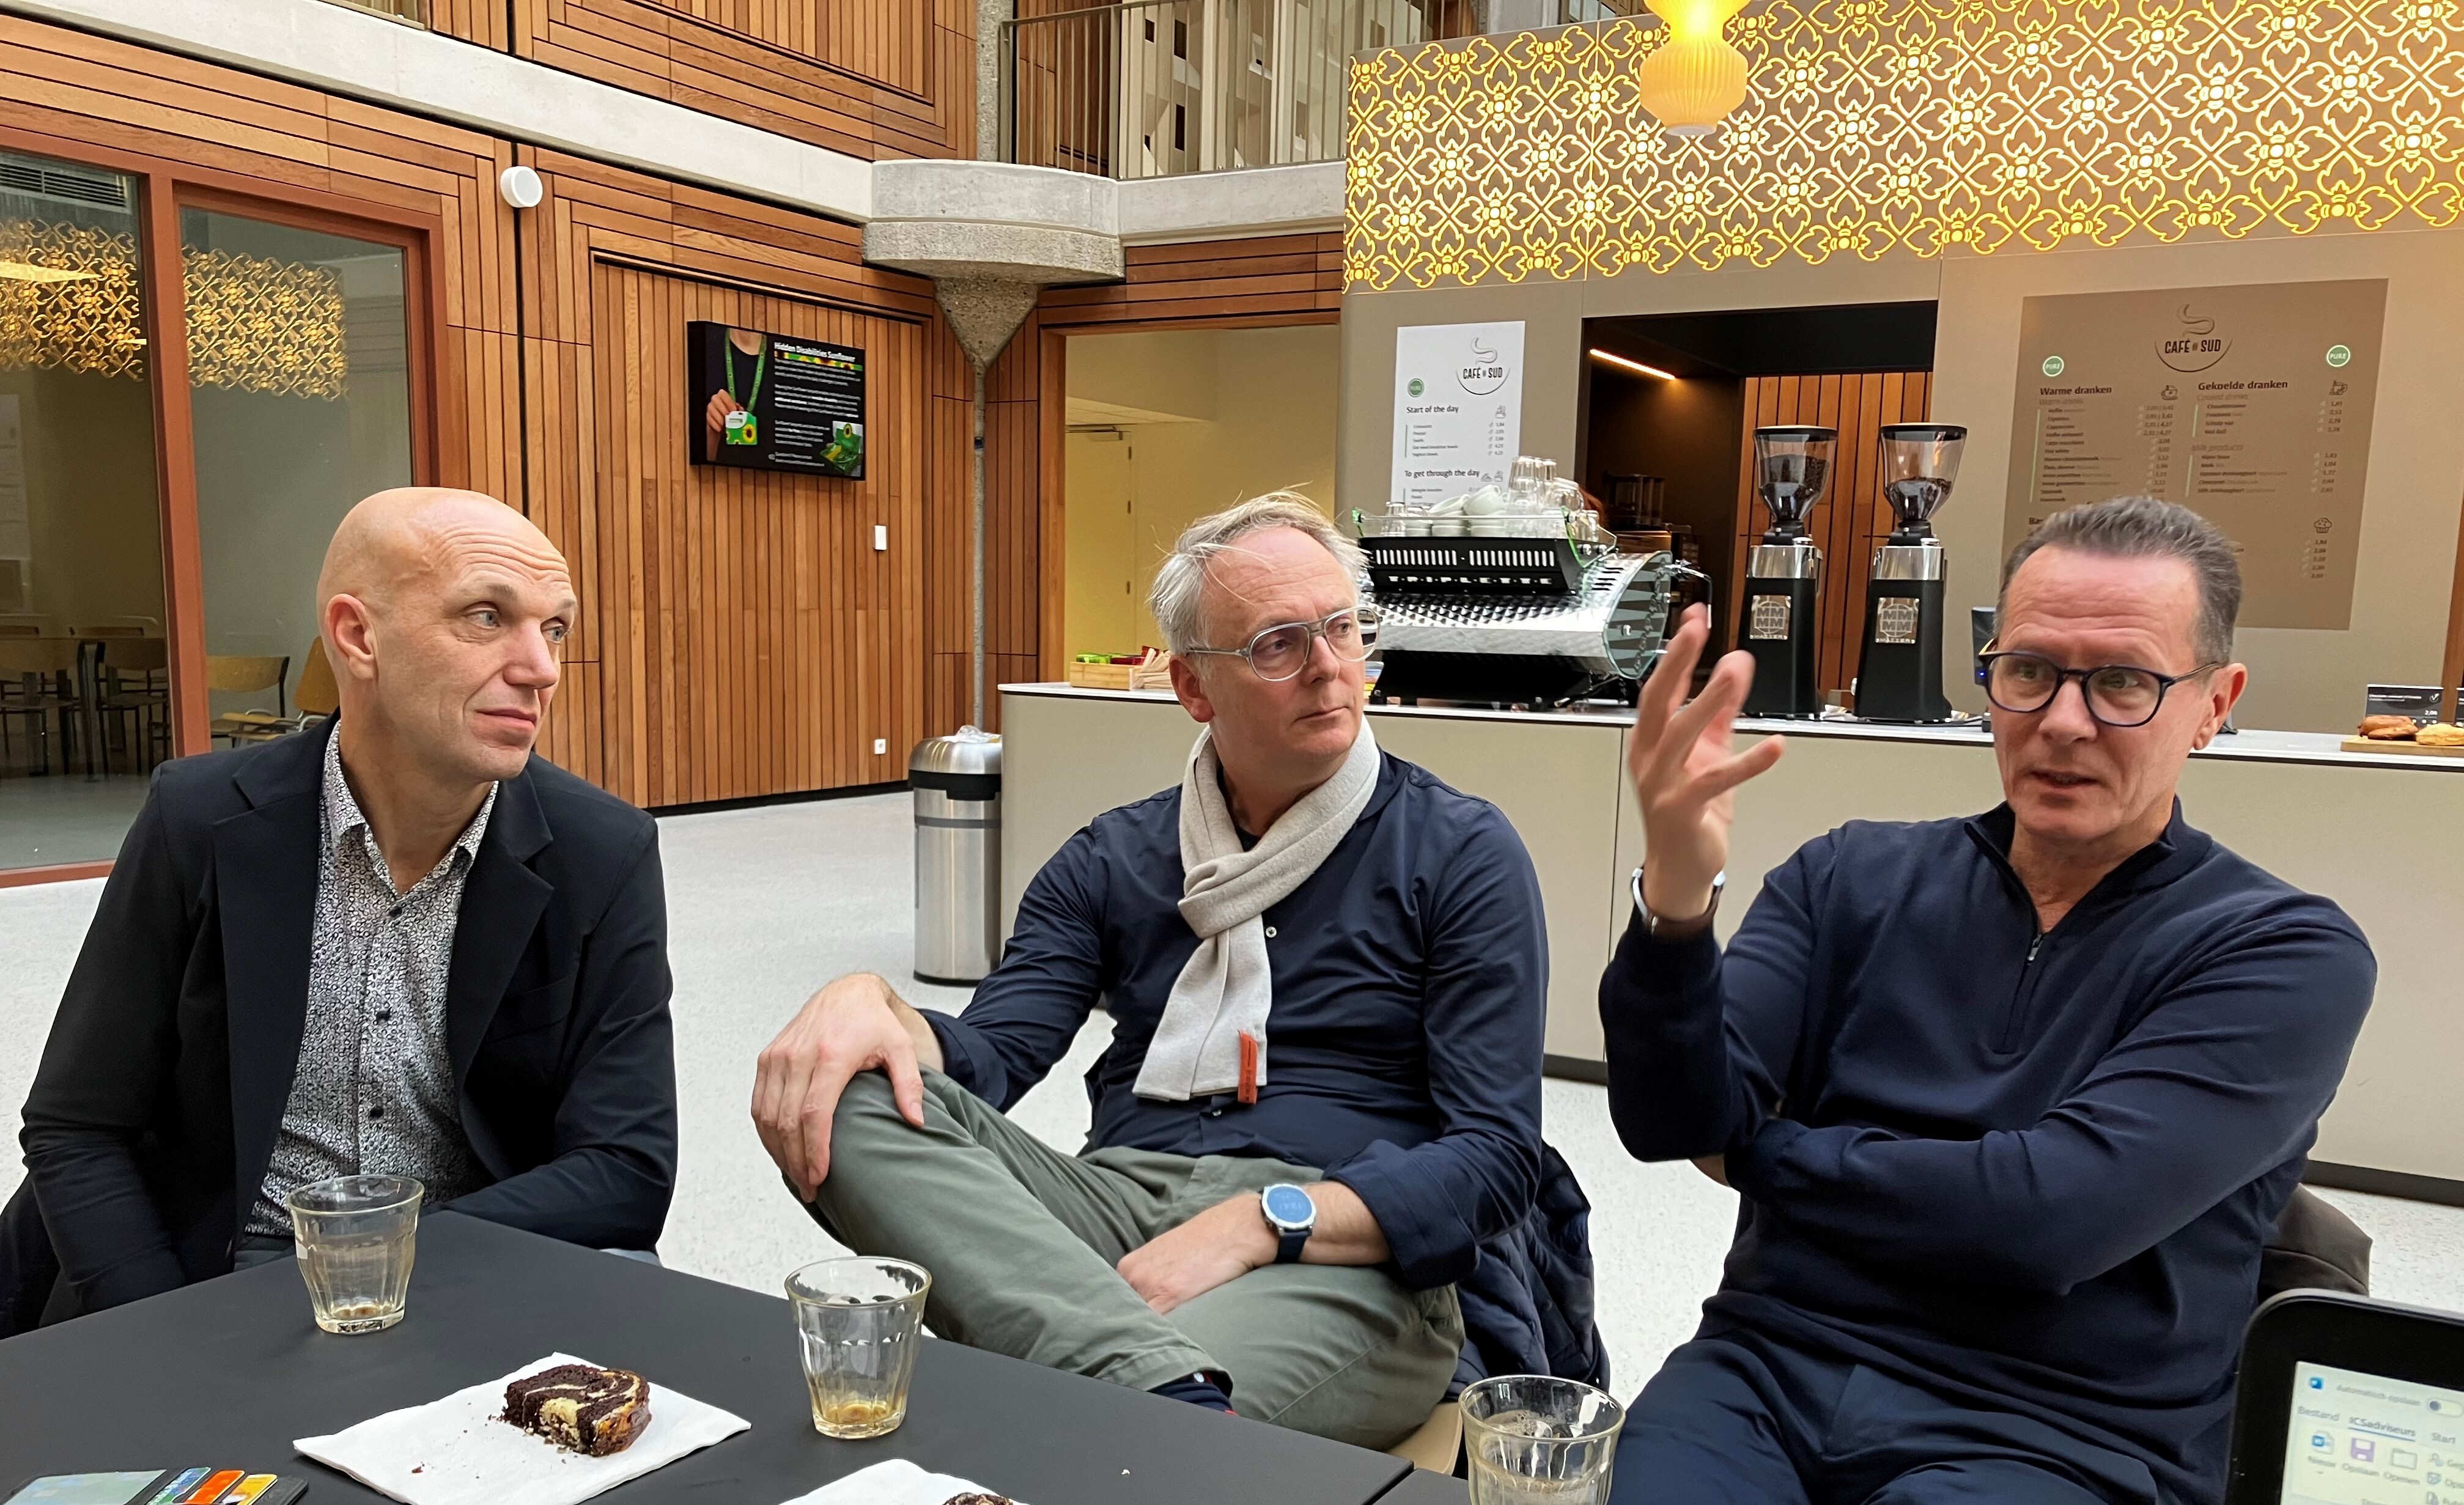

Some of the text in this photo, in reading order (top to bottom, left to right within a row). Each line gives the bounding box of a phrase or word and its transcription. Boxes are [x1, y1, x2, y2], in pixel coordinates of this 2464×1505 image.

[2165, 339, 2190, 353] CAFÉ
[2200, 339, 2221, 353] SUD
[1488, 367, 1503, 379] SUD
[2040, 385, 2112, 396] Warme dranken
[2198, 380, 2288, 390] Gekoelde dranken
[1447, 404, 1459, 414] day
[1414, 470, 1425, 479] get
[1426, 469, 1453, 479] through
[1467, 468, 1480, 478] day
[2297, 1406, 2340, 1422] Bestand
[2431, 1432, 2457, 1444] Start
